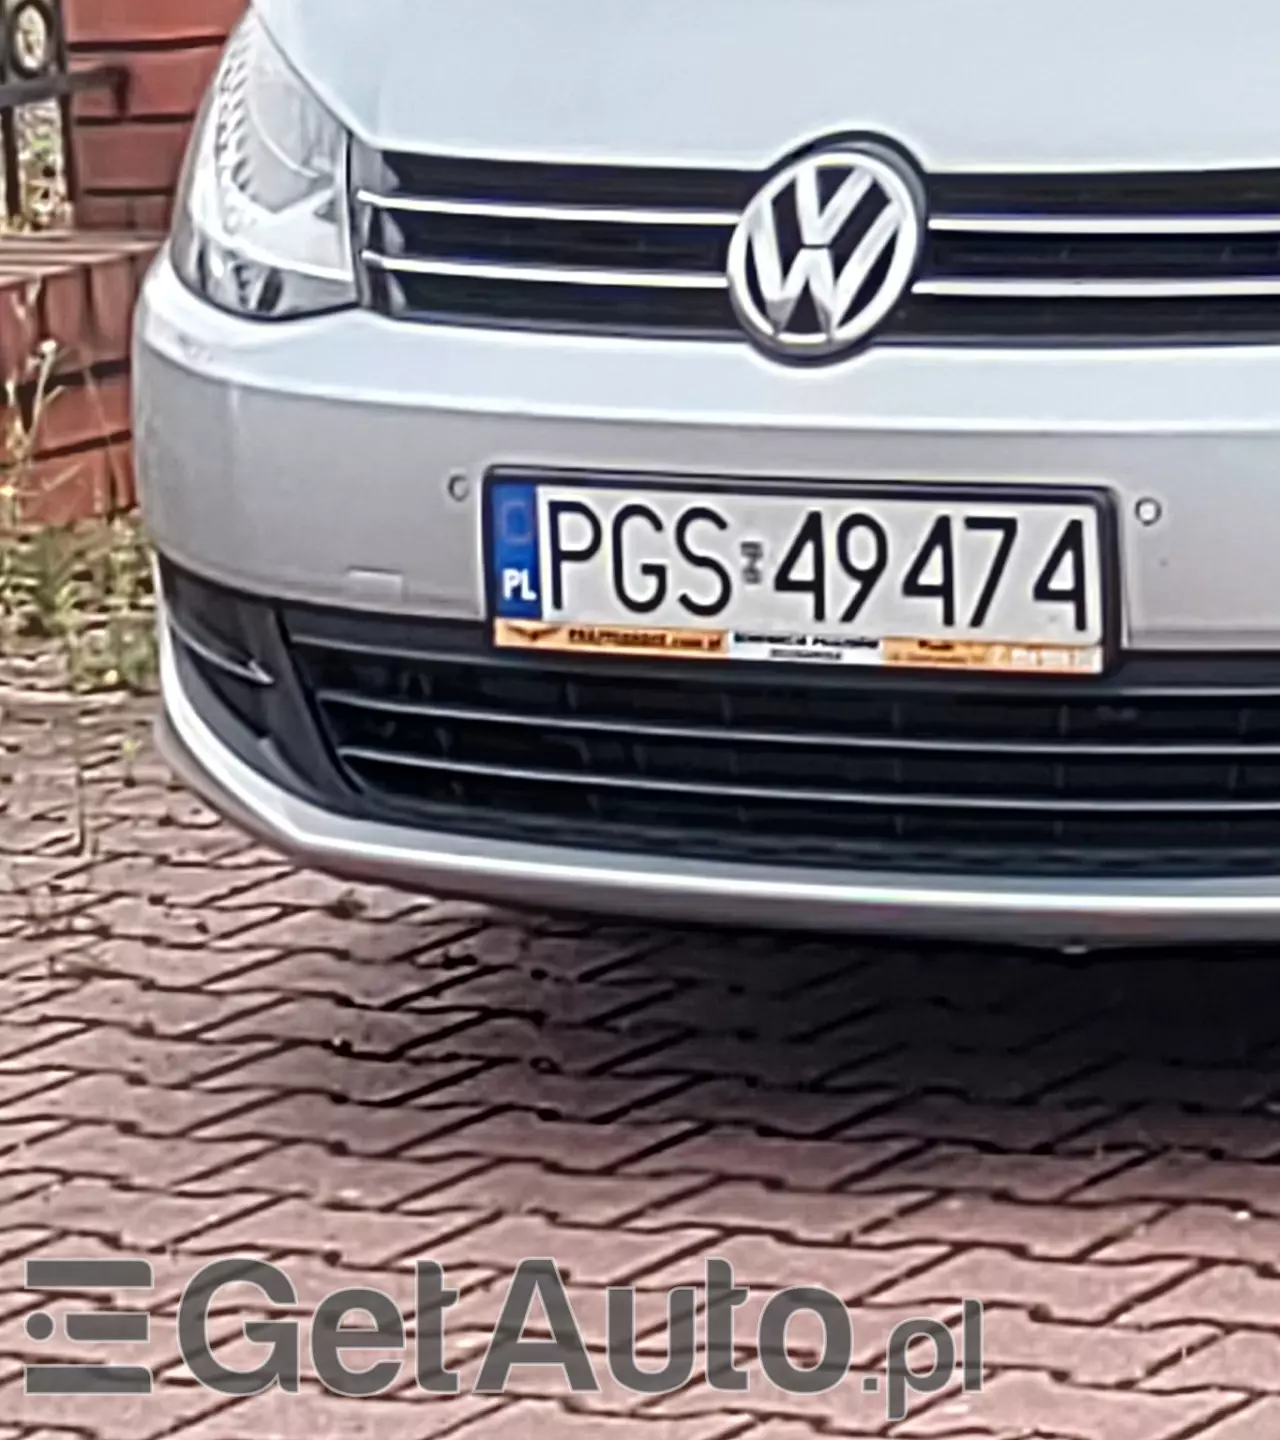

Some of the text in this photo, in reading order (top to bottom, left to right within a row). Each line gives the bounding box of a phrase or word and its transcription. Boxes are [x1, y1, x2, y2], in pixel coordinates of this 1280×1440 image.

[738, 157, 912, 340] VW
[503, 566, 537, 601] PL
[546, 500, 1088, 632] PGS 49474
